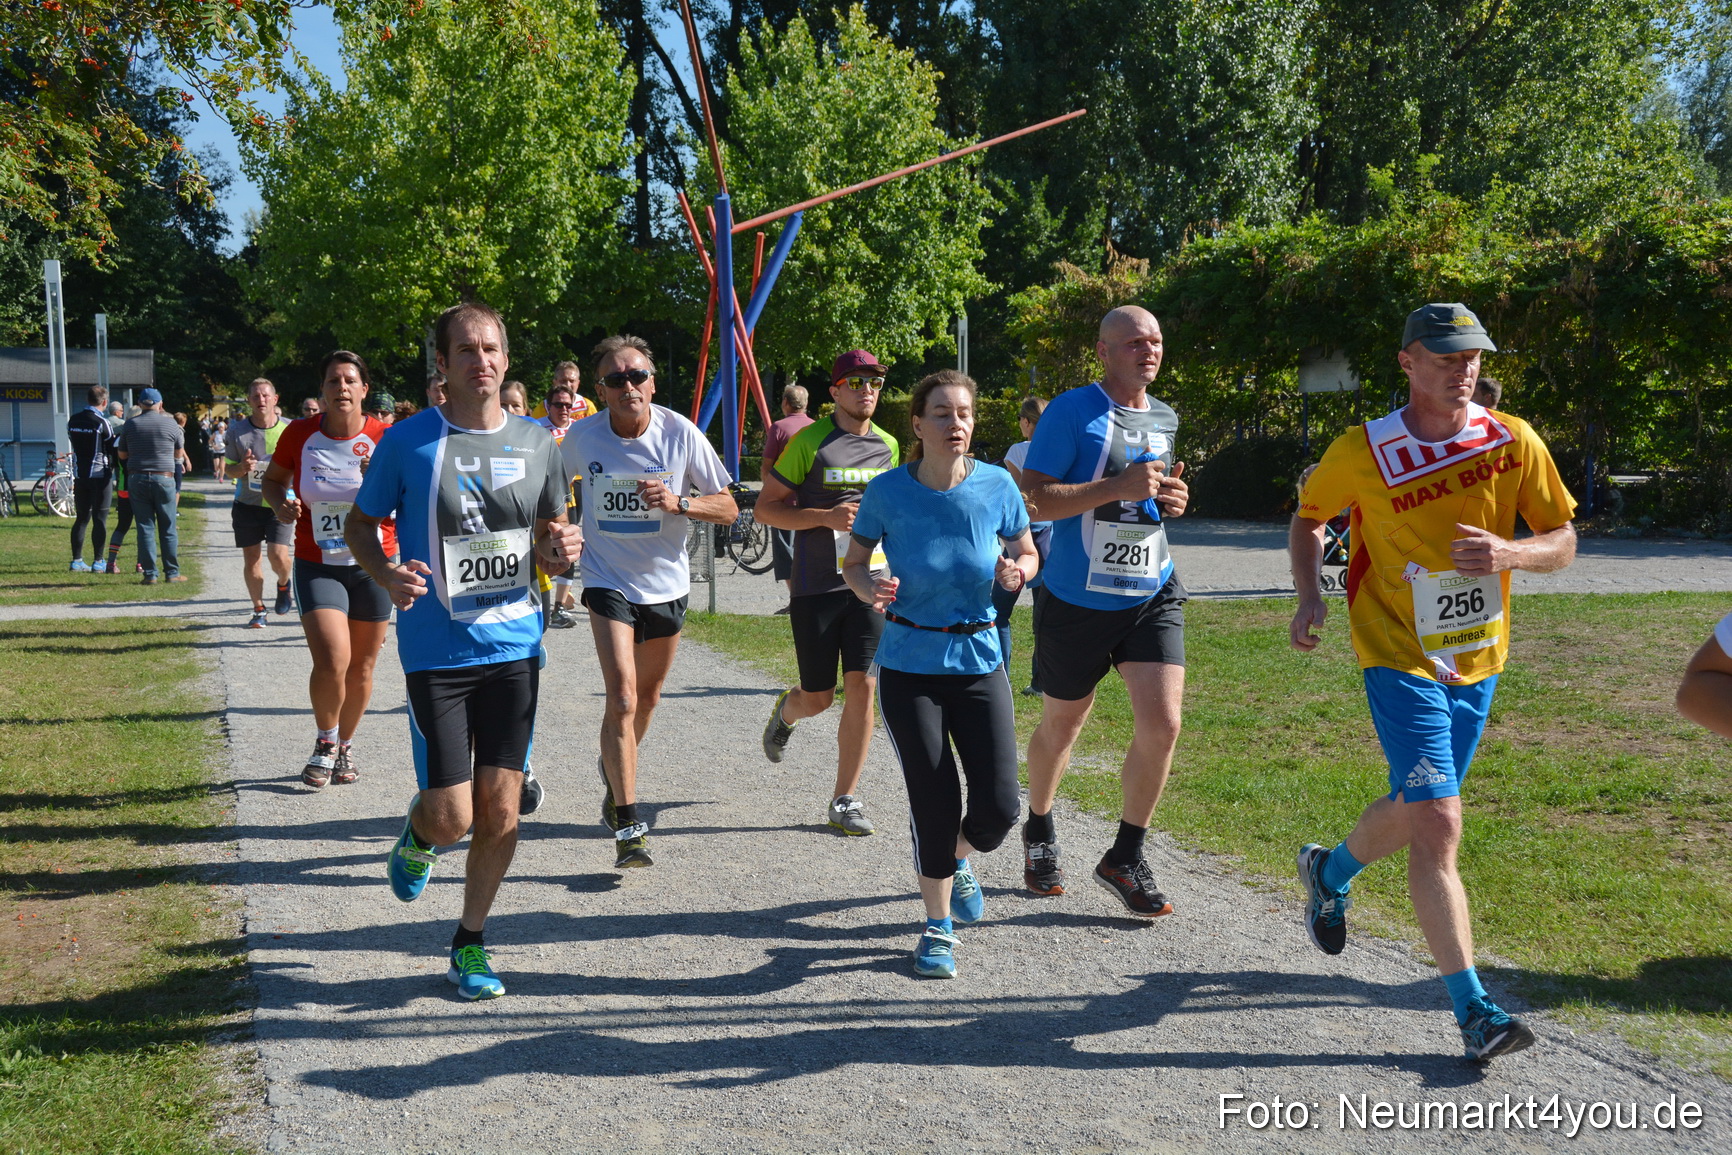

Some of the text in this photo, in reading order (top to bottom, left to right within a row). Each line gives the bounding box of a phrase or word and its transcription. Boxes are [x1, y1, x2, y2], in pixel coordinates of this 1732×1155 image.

[824, 467, 888, 484] BOC
[1391, 453, 1523, 514] MAX BÖGL
[321, 513, 350, 532] 21
[1117, 530, 1146, 539] BOCK
[470, 540, 507, 551] BOCK
[1102, 542, 1150, 567] 2281
[459, 553, 519, 583] 2009
[484, 582, 510, 590] Neumarkt
[1113, 577, 1138, 590] Georg
[475, 594, 508, 607] Martin
[1437, 588, 1484, 621] 256
[1457, 617, 1482, 627] Neumarkt
[1442, 629, 1486, 646] Andreas
[1405, 773, 1447, 788] adidas
